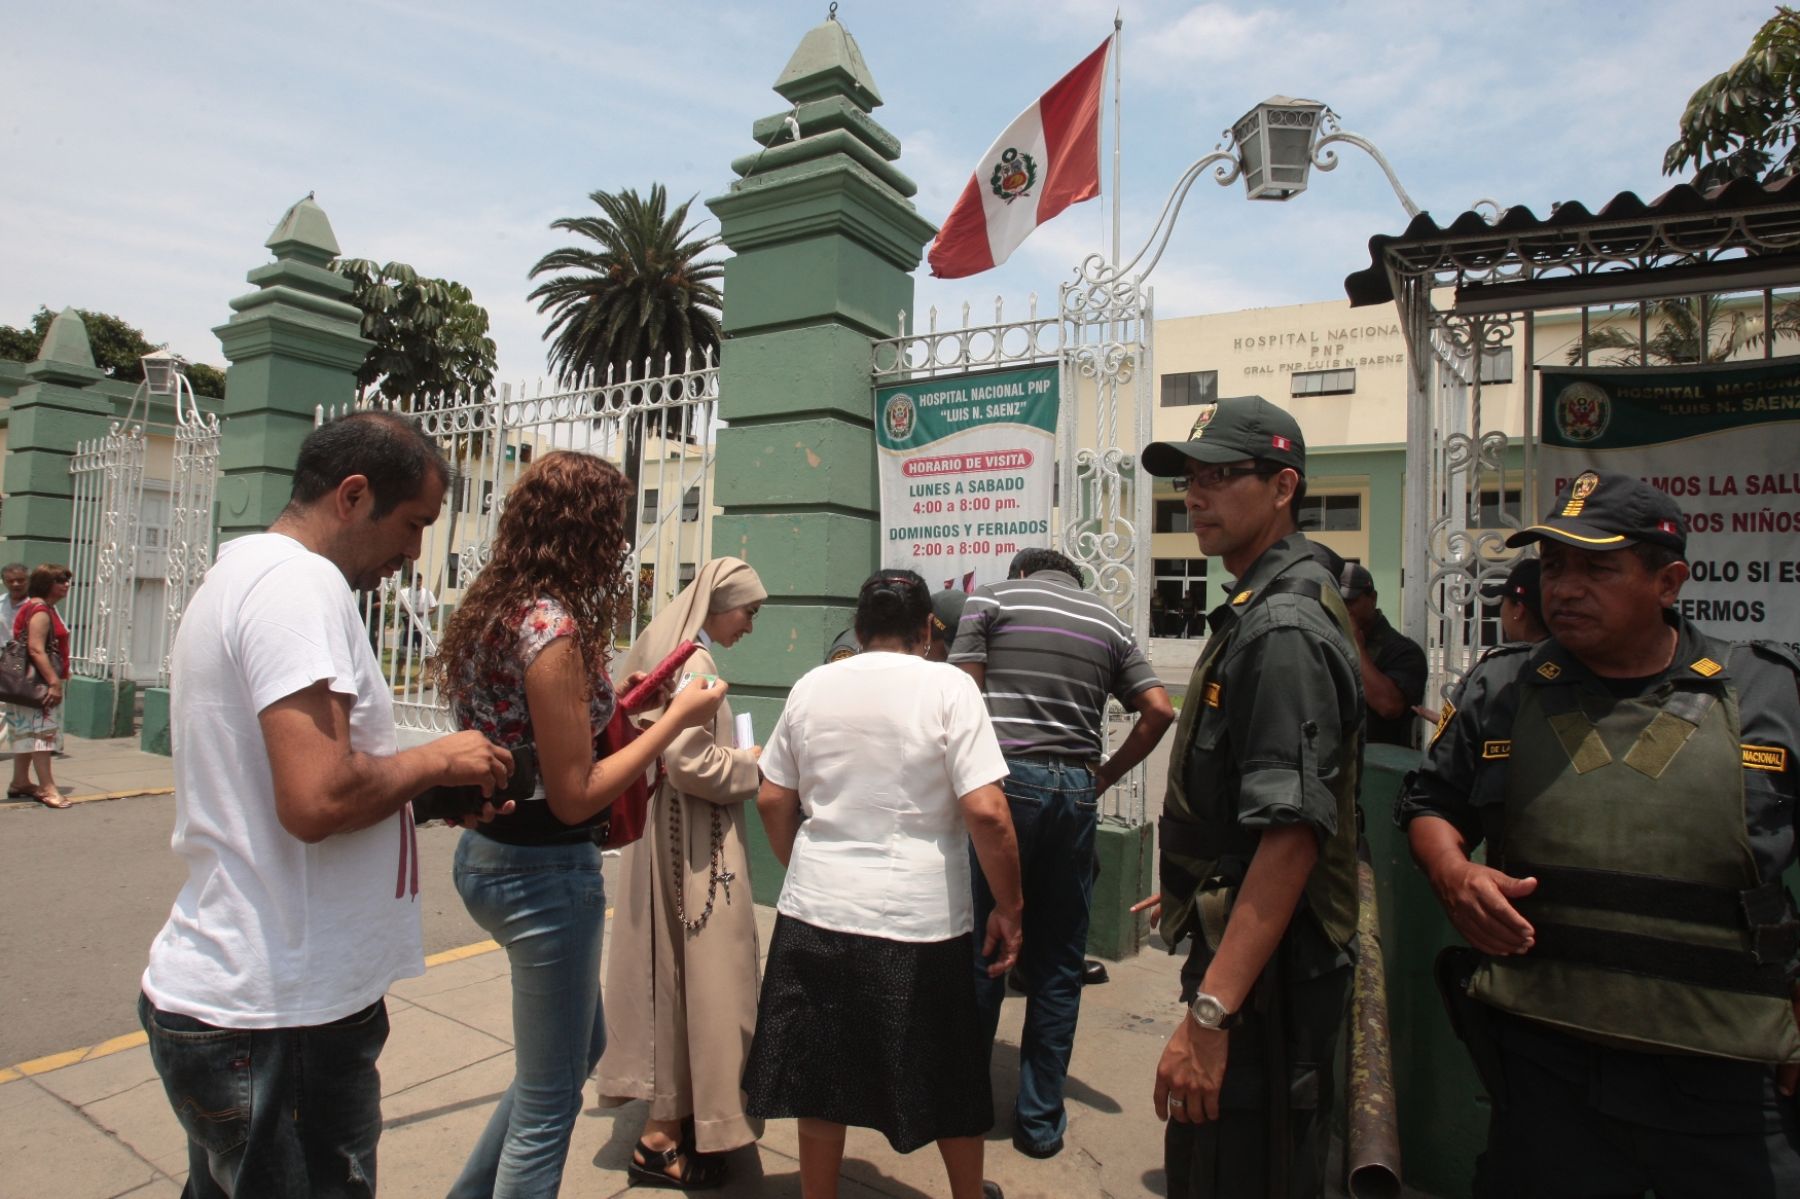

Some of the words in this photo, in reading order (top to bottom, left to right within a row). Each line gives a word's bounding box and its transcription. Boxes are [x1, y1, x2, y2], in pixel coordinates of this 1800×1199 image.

[1234, 332, 1318, 349] HOSPITAL
[1328, 325, 1400, 339] NACIONA
[1311, 345, 1344, 358] PNP
[1244, 365, 1273, 375] GRAL
[919, 389, 968, 407] HOSPITAL
[971, 383, 1024, 401] NACIONAL
[1028, 380, 1050, 394] PNP
[1617, 386, 1703, 399] HOSPITAL
[973, 406, 983, 419] N.
[909, 459, 961, 474] HORARIO
[966, 457, 981, 469] DE
[985, 454, 1026, 467] VISITA
[909, 482, 950, 497] LUNES
[955, 481, 963, 493] A
[968, 477, 1024, 493] SABADO
[1709, 475, 1739, 496] LA
[913, 501, 942, 514] 4:00
[947, 502, 954, 512] a
[960, 498, 990, 511] 8:00
[995, 498, 1020, 512] pm.
[890, 524, 959, 540] DOMINGOS
[964, 524, 972, 536] Y
[977, 520, 1047, 536] FERIADOS
[913, 543, 942, 556] 2:00
[946, 545, 954, 554] a
[960, 541, 990, 554] 8:00
[995, 543, 1019, 556] pm.
[1748, 561, 1769, 583] SI
[1742, 751, 1781, 765] NACIONAL
